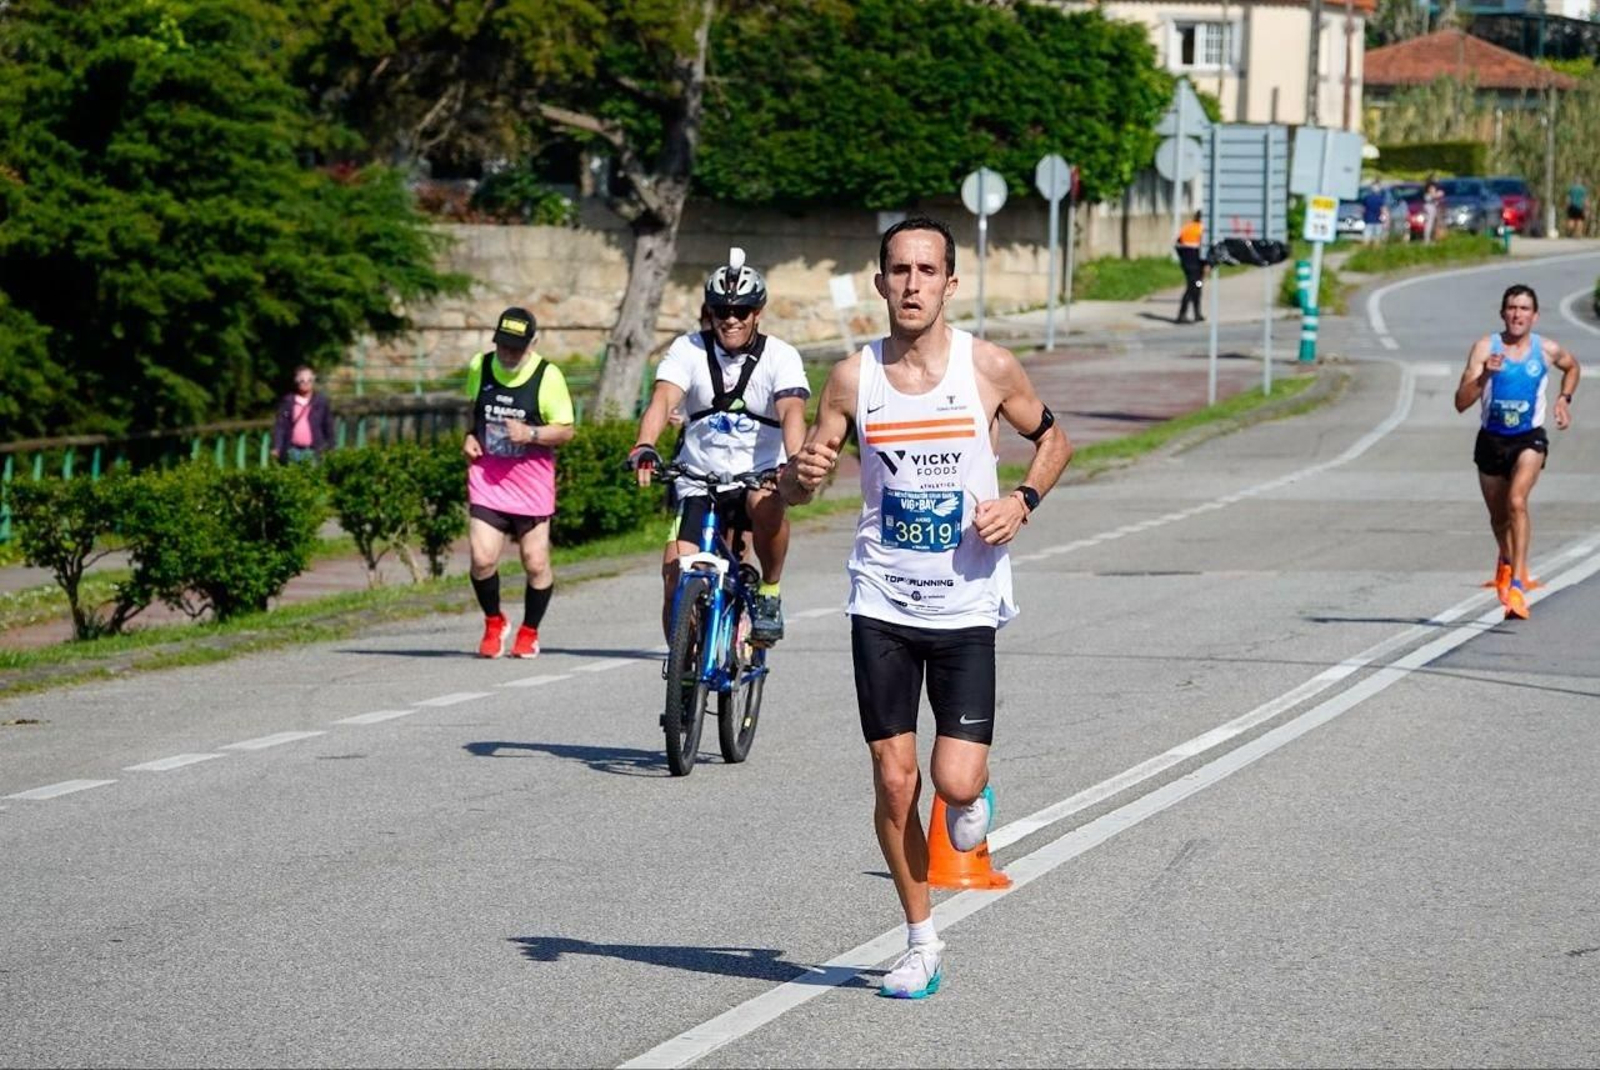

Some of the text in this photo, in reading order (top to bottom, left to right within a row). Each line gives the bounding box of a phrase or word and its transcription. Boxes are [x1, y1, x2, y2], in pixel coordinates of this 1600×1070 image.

[911, 452, 962, 466] VICKY
[917, 466, 957, 476] FOODS
[896, 521, 952, 544] 3819
